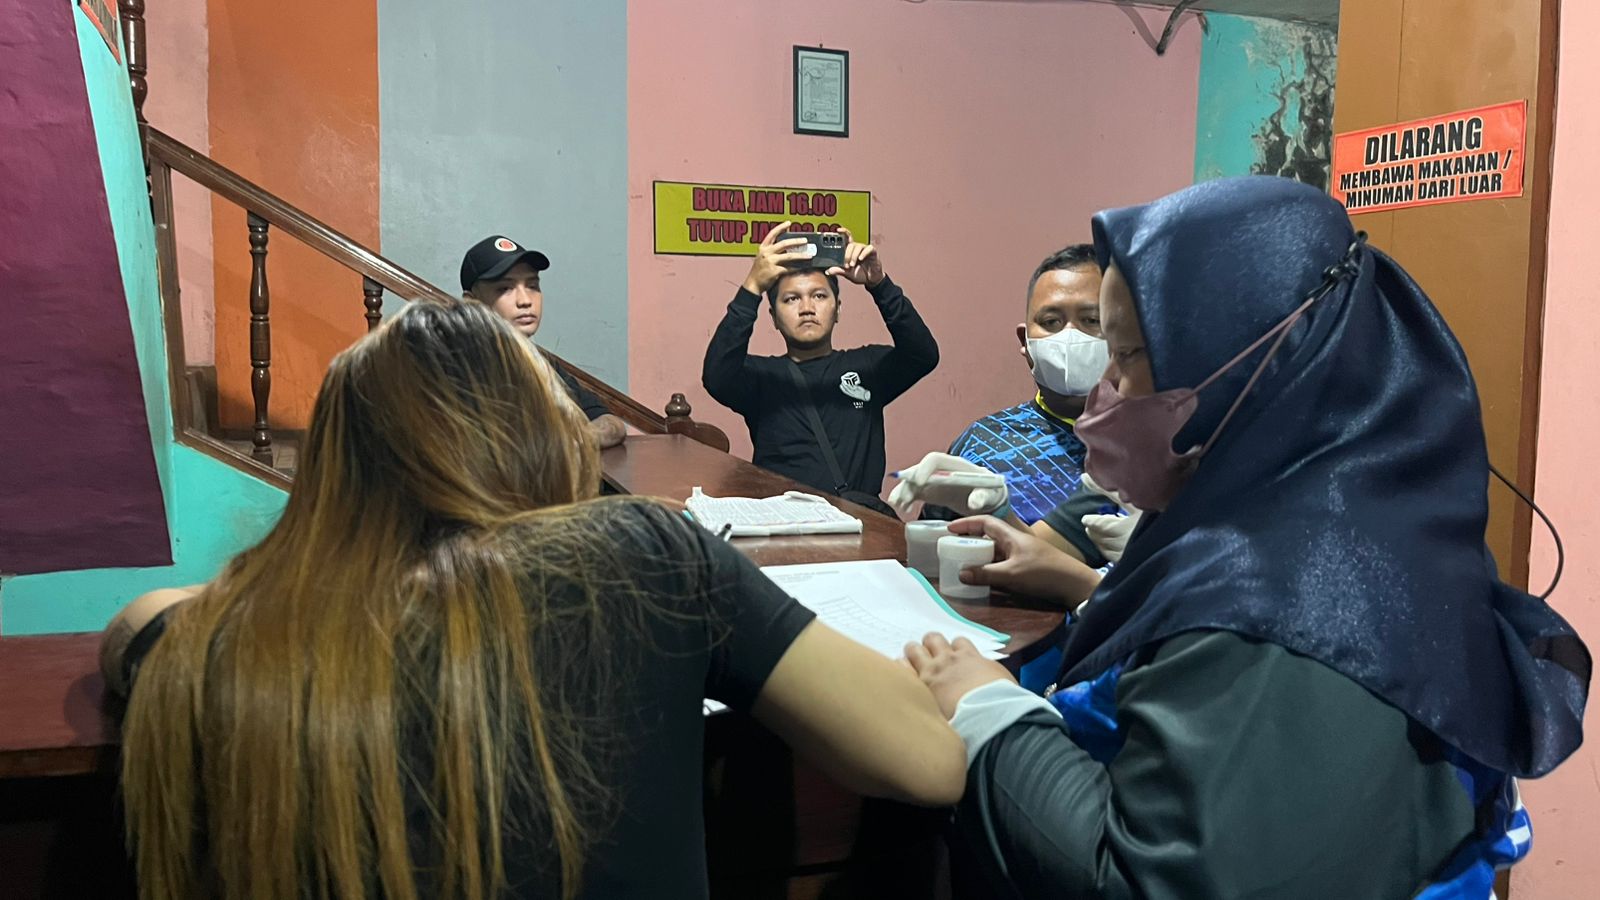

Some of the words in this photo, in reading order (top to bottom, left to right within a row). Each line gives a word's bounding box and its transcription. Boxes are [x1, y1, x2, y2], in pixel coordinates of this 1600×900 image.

[1365, 117, 1482, 165] DILARANG
[1340, 164, 1414, 190] MEMBAWA
[1418, 152, 1498, 180] MAKANAN
[693, 187, 746, 213] BUKA
[747, 190, 785, 214] JAM
[786, 192, 837, 217] 16.00
[1345, 184, 1414, 208] MINUMAN
[1418, 179, 1455, 199] DARI
[1460, 173, 1502, 195] LUAR
[687, 218, 748, 243] TUTUP
